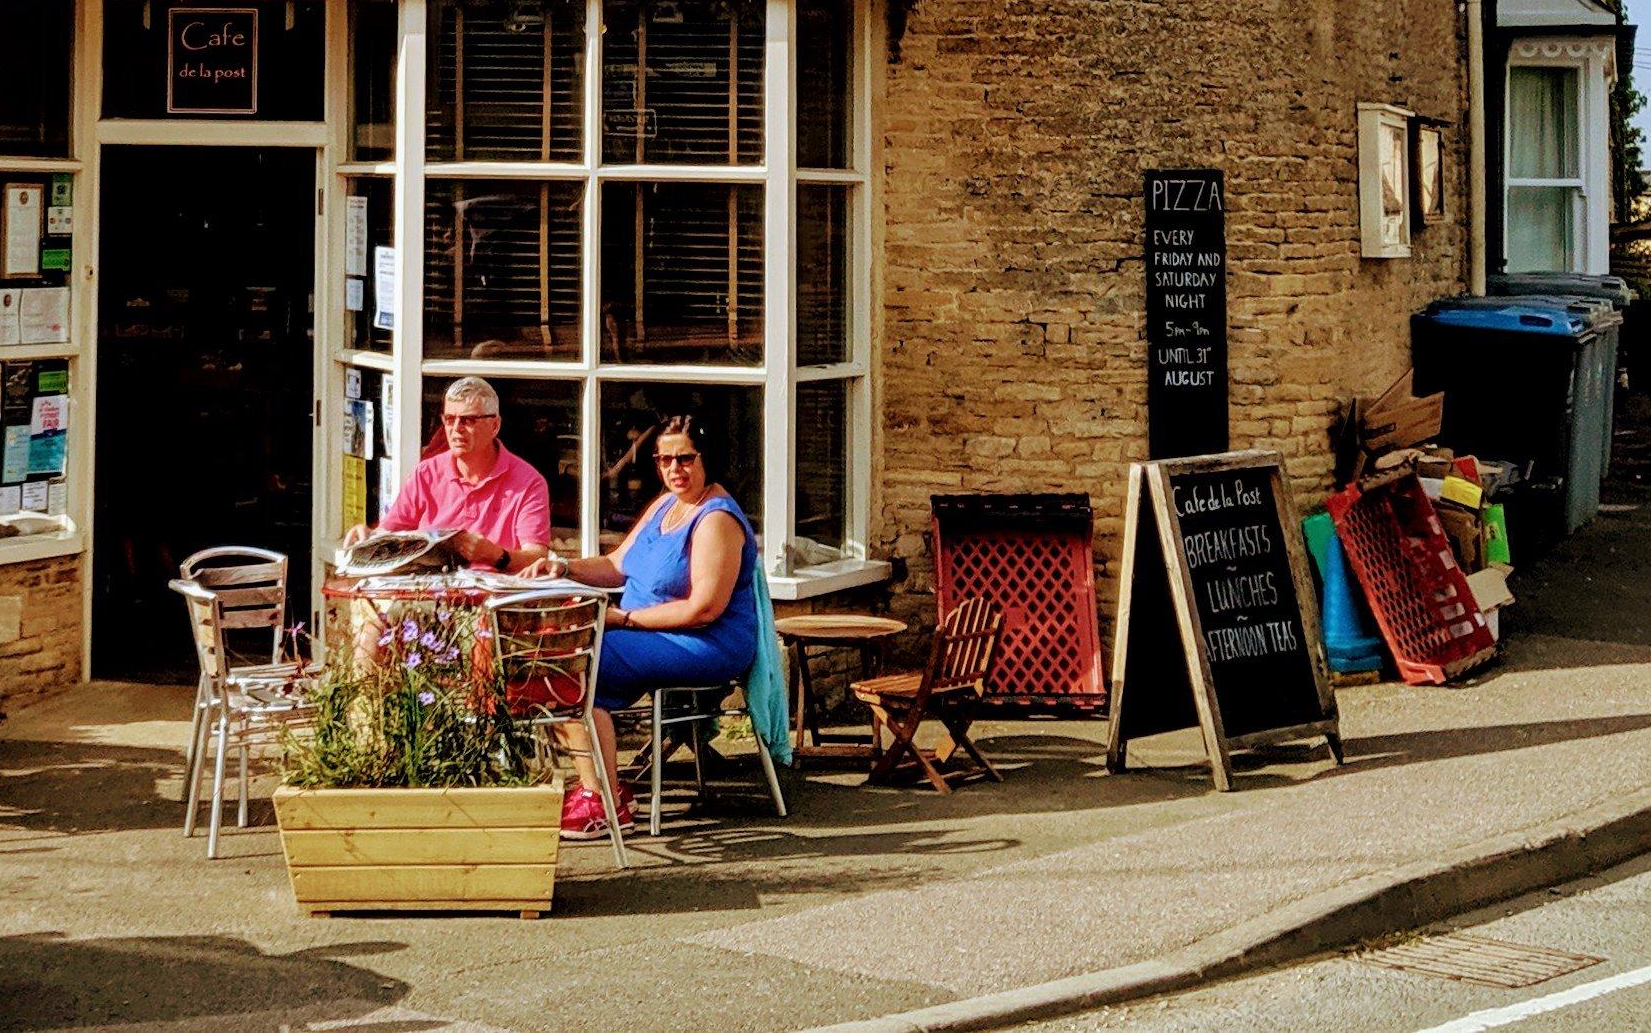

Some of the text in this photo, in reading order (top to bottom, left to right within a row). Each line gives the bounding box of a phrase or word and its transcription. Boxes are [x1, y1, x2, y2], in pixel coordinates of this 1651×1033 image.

[179, 63, 246, 83] de la post
[1153, 179, 1222, 211] PIZZA
[1154, 229, 1194, 245] EVERY
[1154, 251, 1221, 266] FRIDAY AND
[1155, 271, 1217, 287] SATURDAY
[1165, 293, 1206, 309] NIGHT
[1158, 347, 1195, 365] UNTIL
[1164, 370, 1215, 386] AUGUST
[1208, 485, 1221, 511] de
[1221, 483, 1234, 508] la
[1235, 478, 1262, 506] Post
[1184, 524, 1270, 568] BREAKFASTS
[1207, 571, 1278, 613] LUNCHES
[1266, 620, 1297, 653] TEAS
